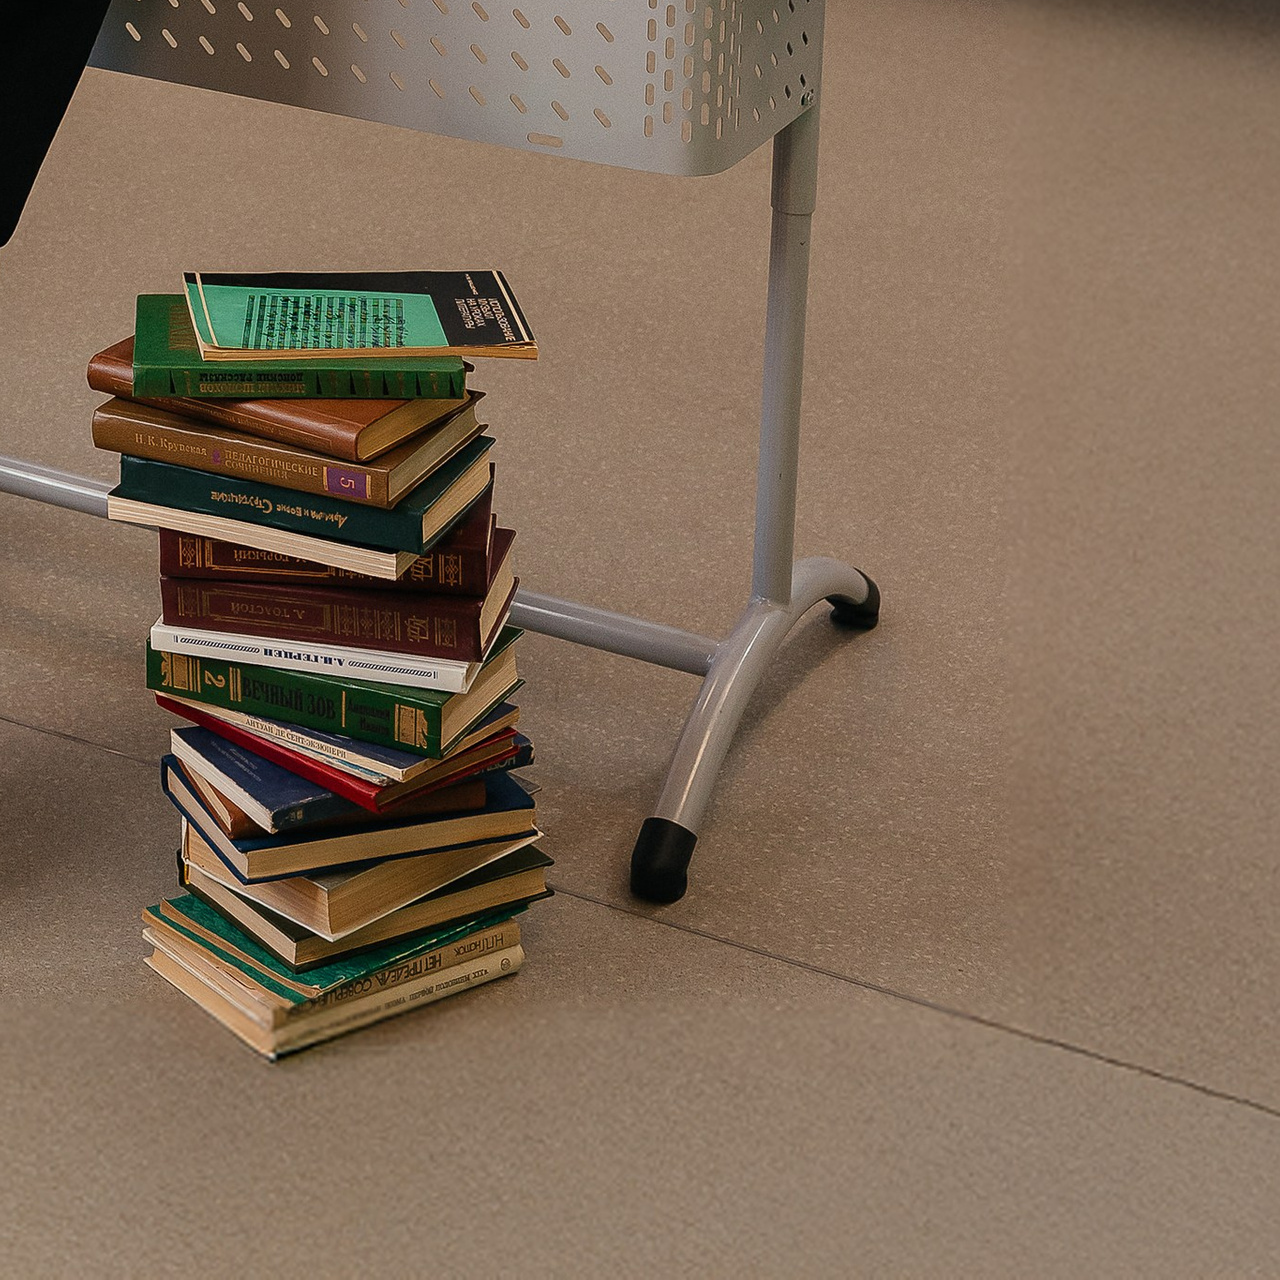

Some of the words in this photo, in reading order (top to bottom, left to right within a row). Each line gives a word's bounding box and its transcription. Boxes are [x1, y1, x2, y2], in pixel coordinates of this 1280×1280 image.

[160, 438, 207, 457] Крупская
[224, 449, 319, 476] ПЕДАГОГИЧЕСКИЕ
[224, 460, 289, 480] СОЧИНЕНИЯ
[339, 476, 355, 490] 5
[230, 602, 290, 618] ТОЛСТОЙ
[204, 670, 226, 688] 2
[242, 676, 303, 712] ВЕЧНЫЙ
[307, 694, 336, 719] ЗОВ
[245, 718, 274, 734] АНТУАН
[275, 728, 286, 738] ДЕ
[286, 730, 347, 759] СЕНТ-ЭКЗЮПЕРИ
[425, 952, 442, 973] НЕТ
[375, 961, 424, 988] ПРЕДЕЛА
